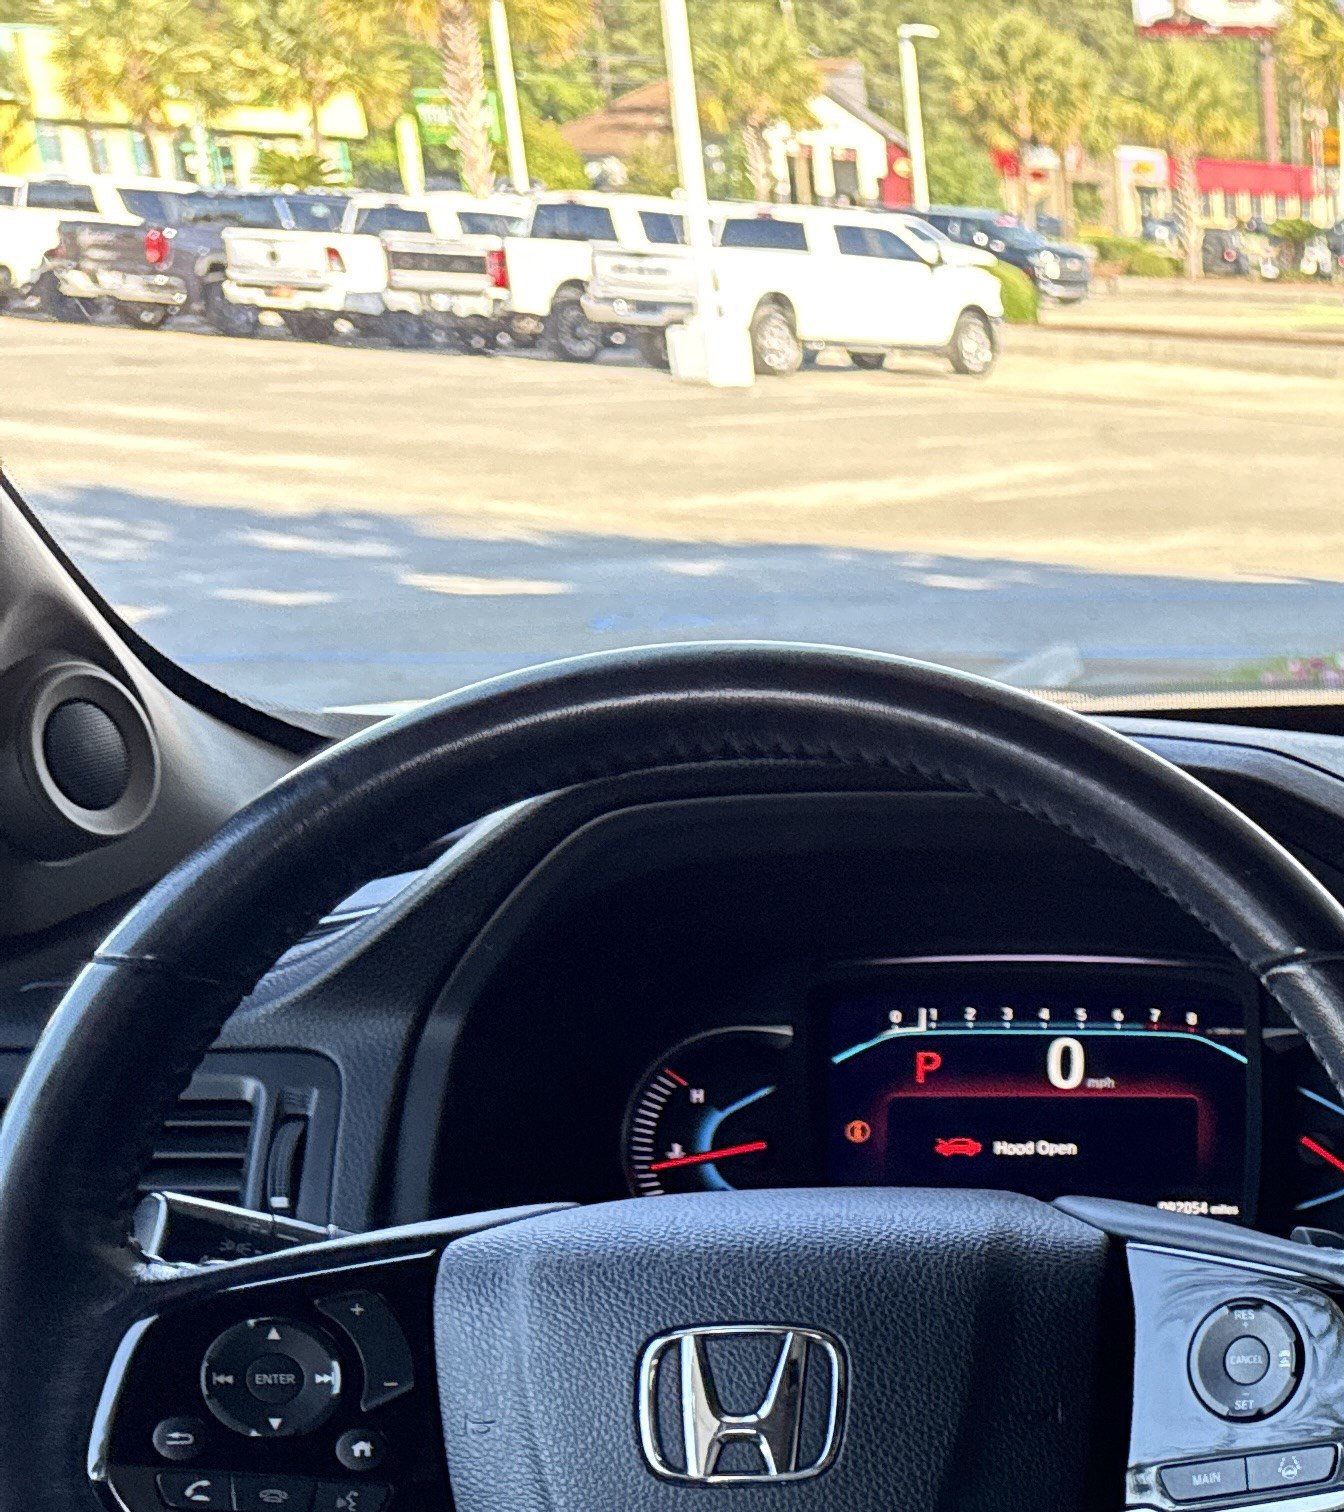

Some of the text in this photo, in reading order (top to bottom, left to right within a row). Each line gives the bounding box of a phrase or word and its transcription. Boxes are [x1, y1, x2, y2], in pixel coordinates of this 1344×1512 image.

[964, 1007, 977, 1021] 2
[1001, 1007, 1014, 1021] 3
[1075, 1007, 1088, 1021] 5
[1149, 1007, 1162, 1022] 7
[915, 1052, 942, 1084] P
[1047, 1037, 1116, 1090] 0 mph
[689, 1088, 706, 1104] H
[993, 1140, 1078, 1157] Hood Open
[1234, 1310, 1255, 1321] RES
[1229, 1355, 1264, 1366] CANCEL
[254, 1373, 296, 1385] ENTER
[1234, 1400, 1255, 1411] SET
[1191, 1472, 1221, 1486] MAIN
